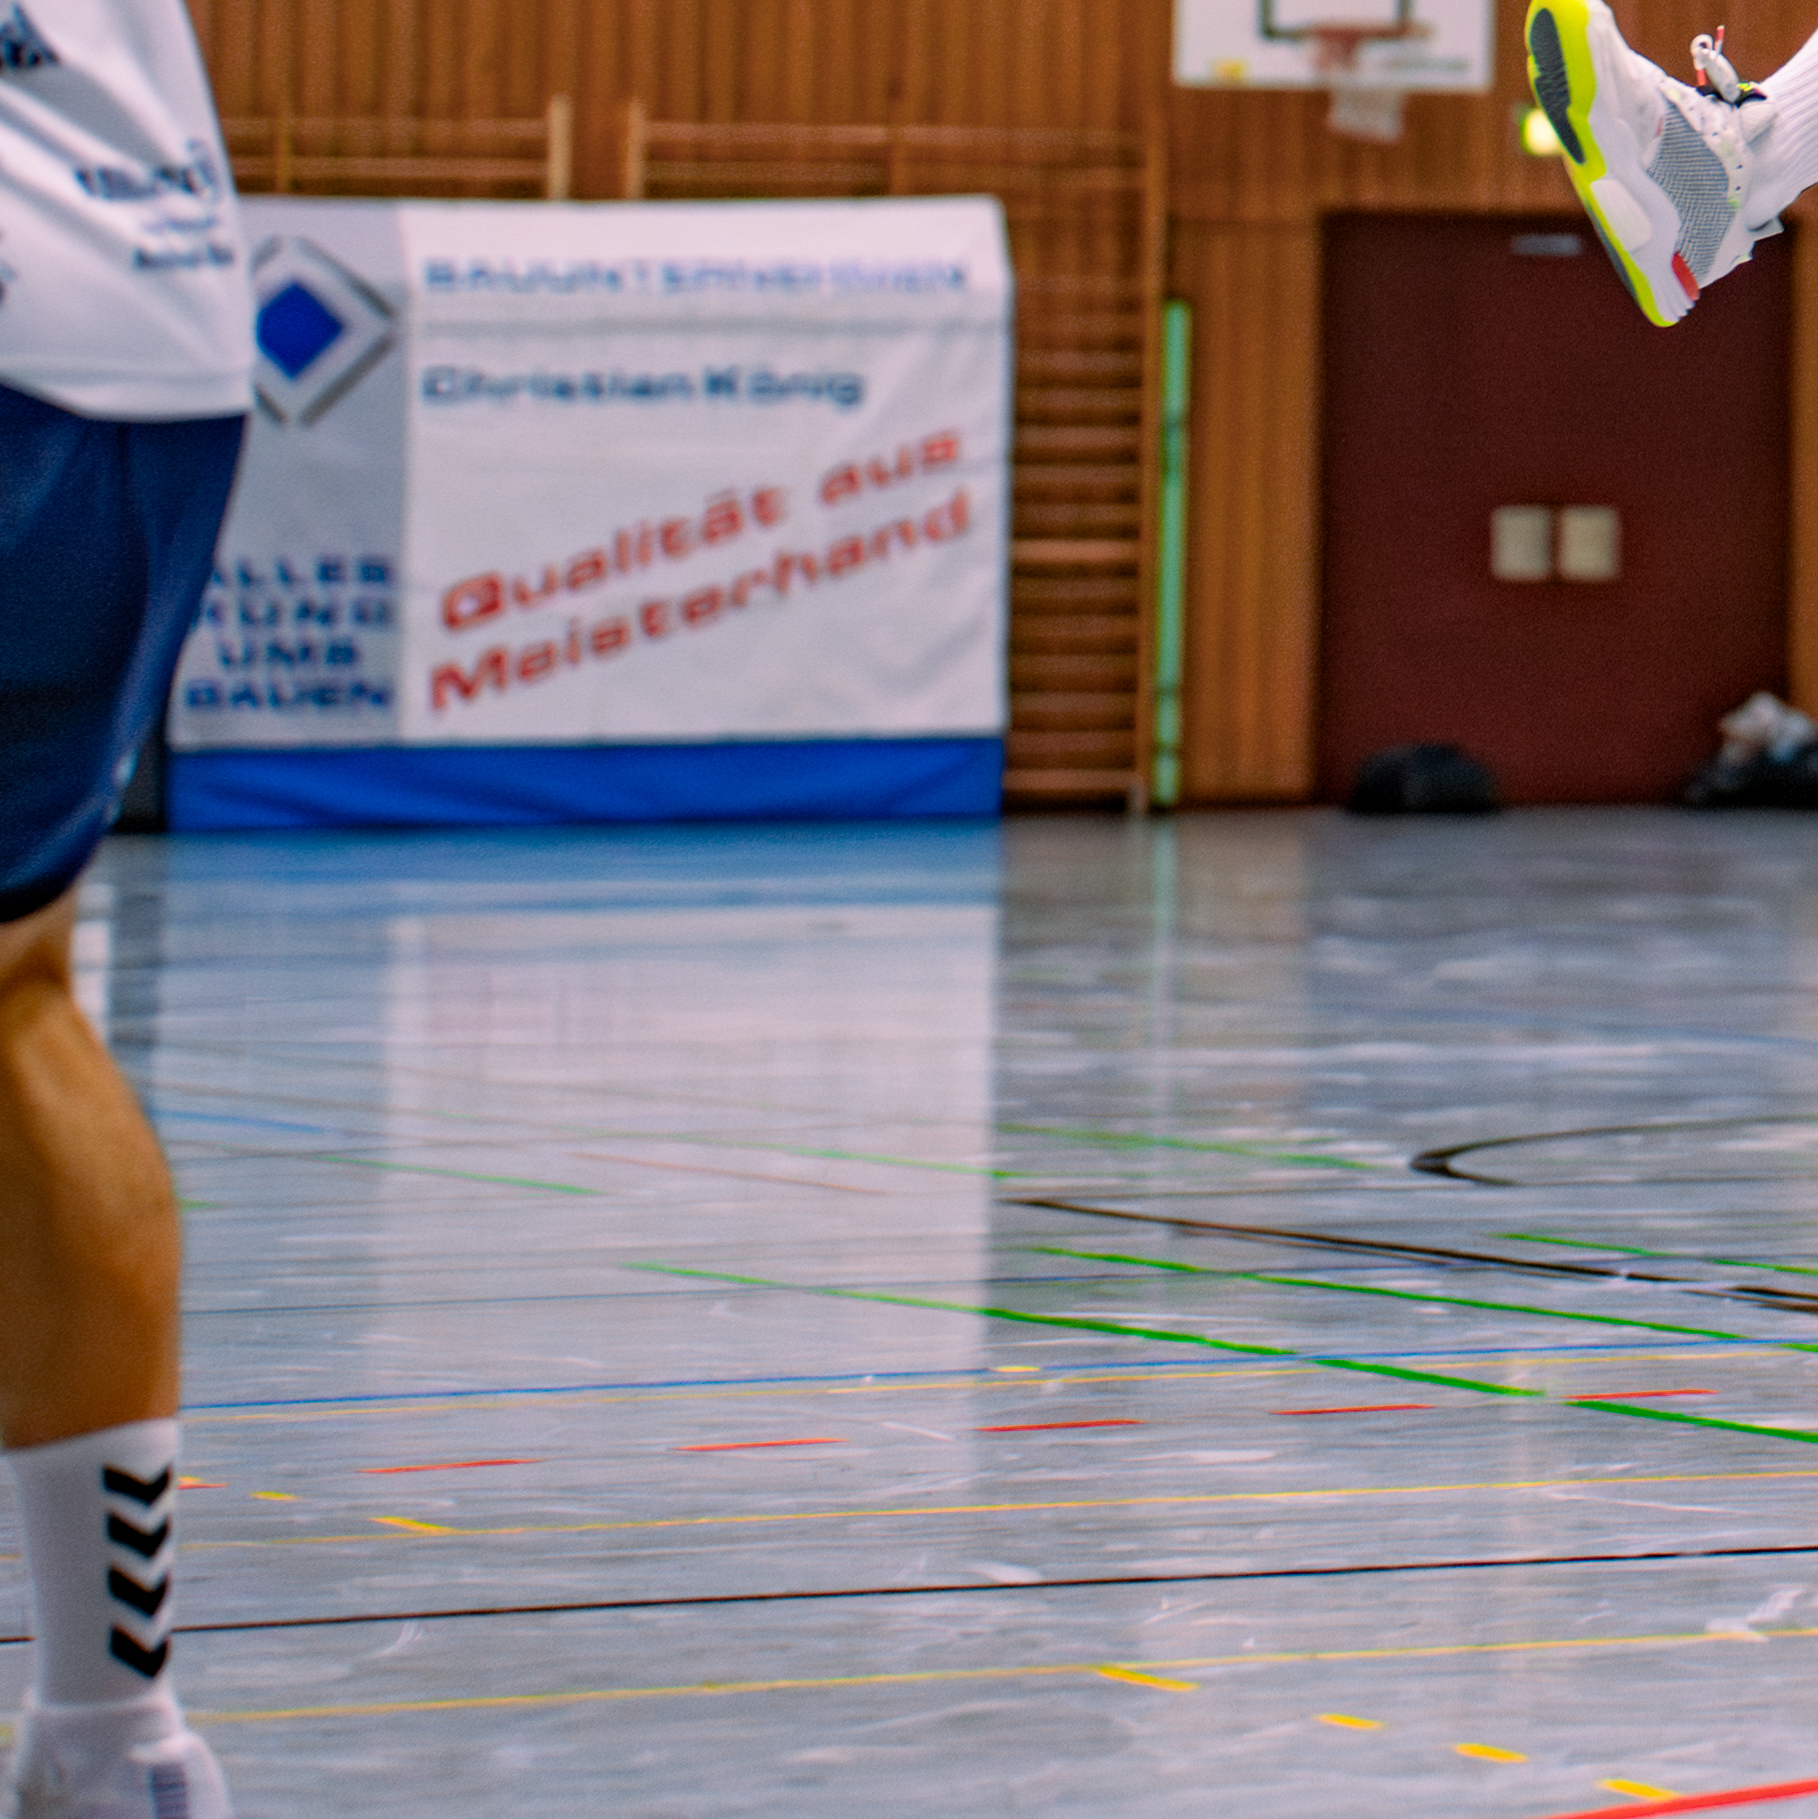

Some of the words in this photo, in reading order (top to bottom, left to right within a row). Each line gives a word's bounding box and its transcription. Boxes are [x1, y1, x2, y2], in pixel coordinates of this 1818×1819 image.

[422, 364, 696, 408] Christian
[430, 490, 973, 711] Meisterhand
[442, 480, 787, 632] Qualität
[820, 425, 961, 510] aus
